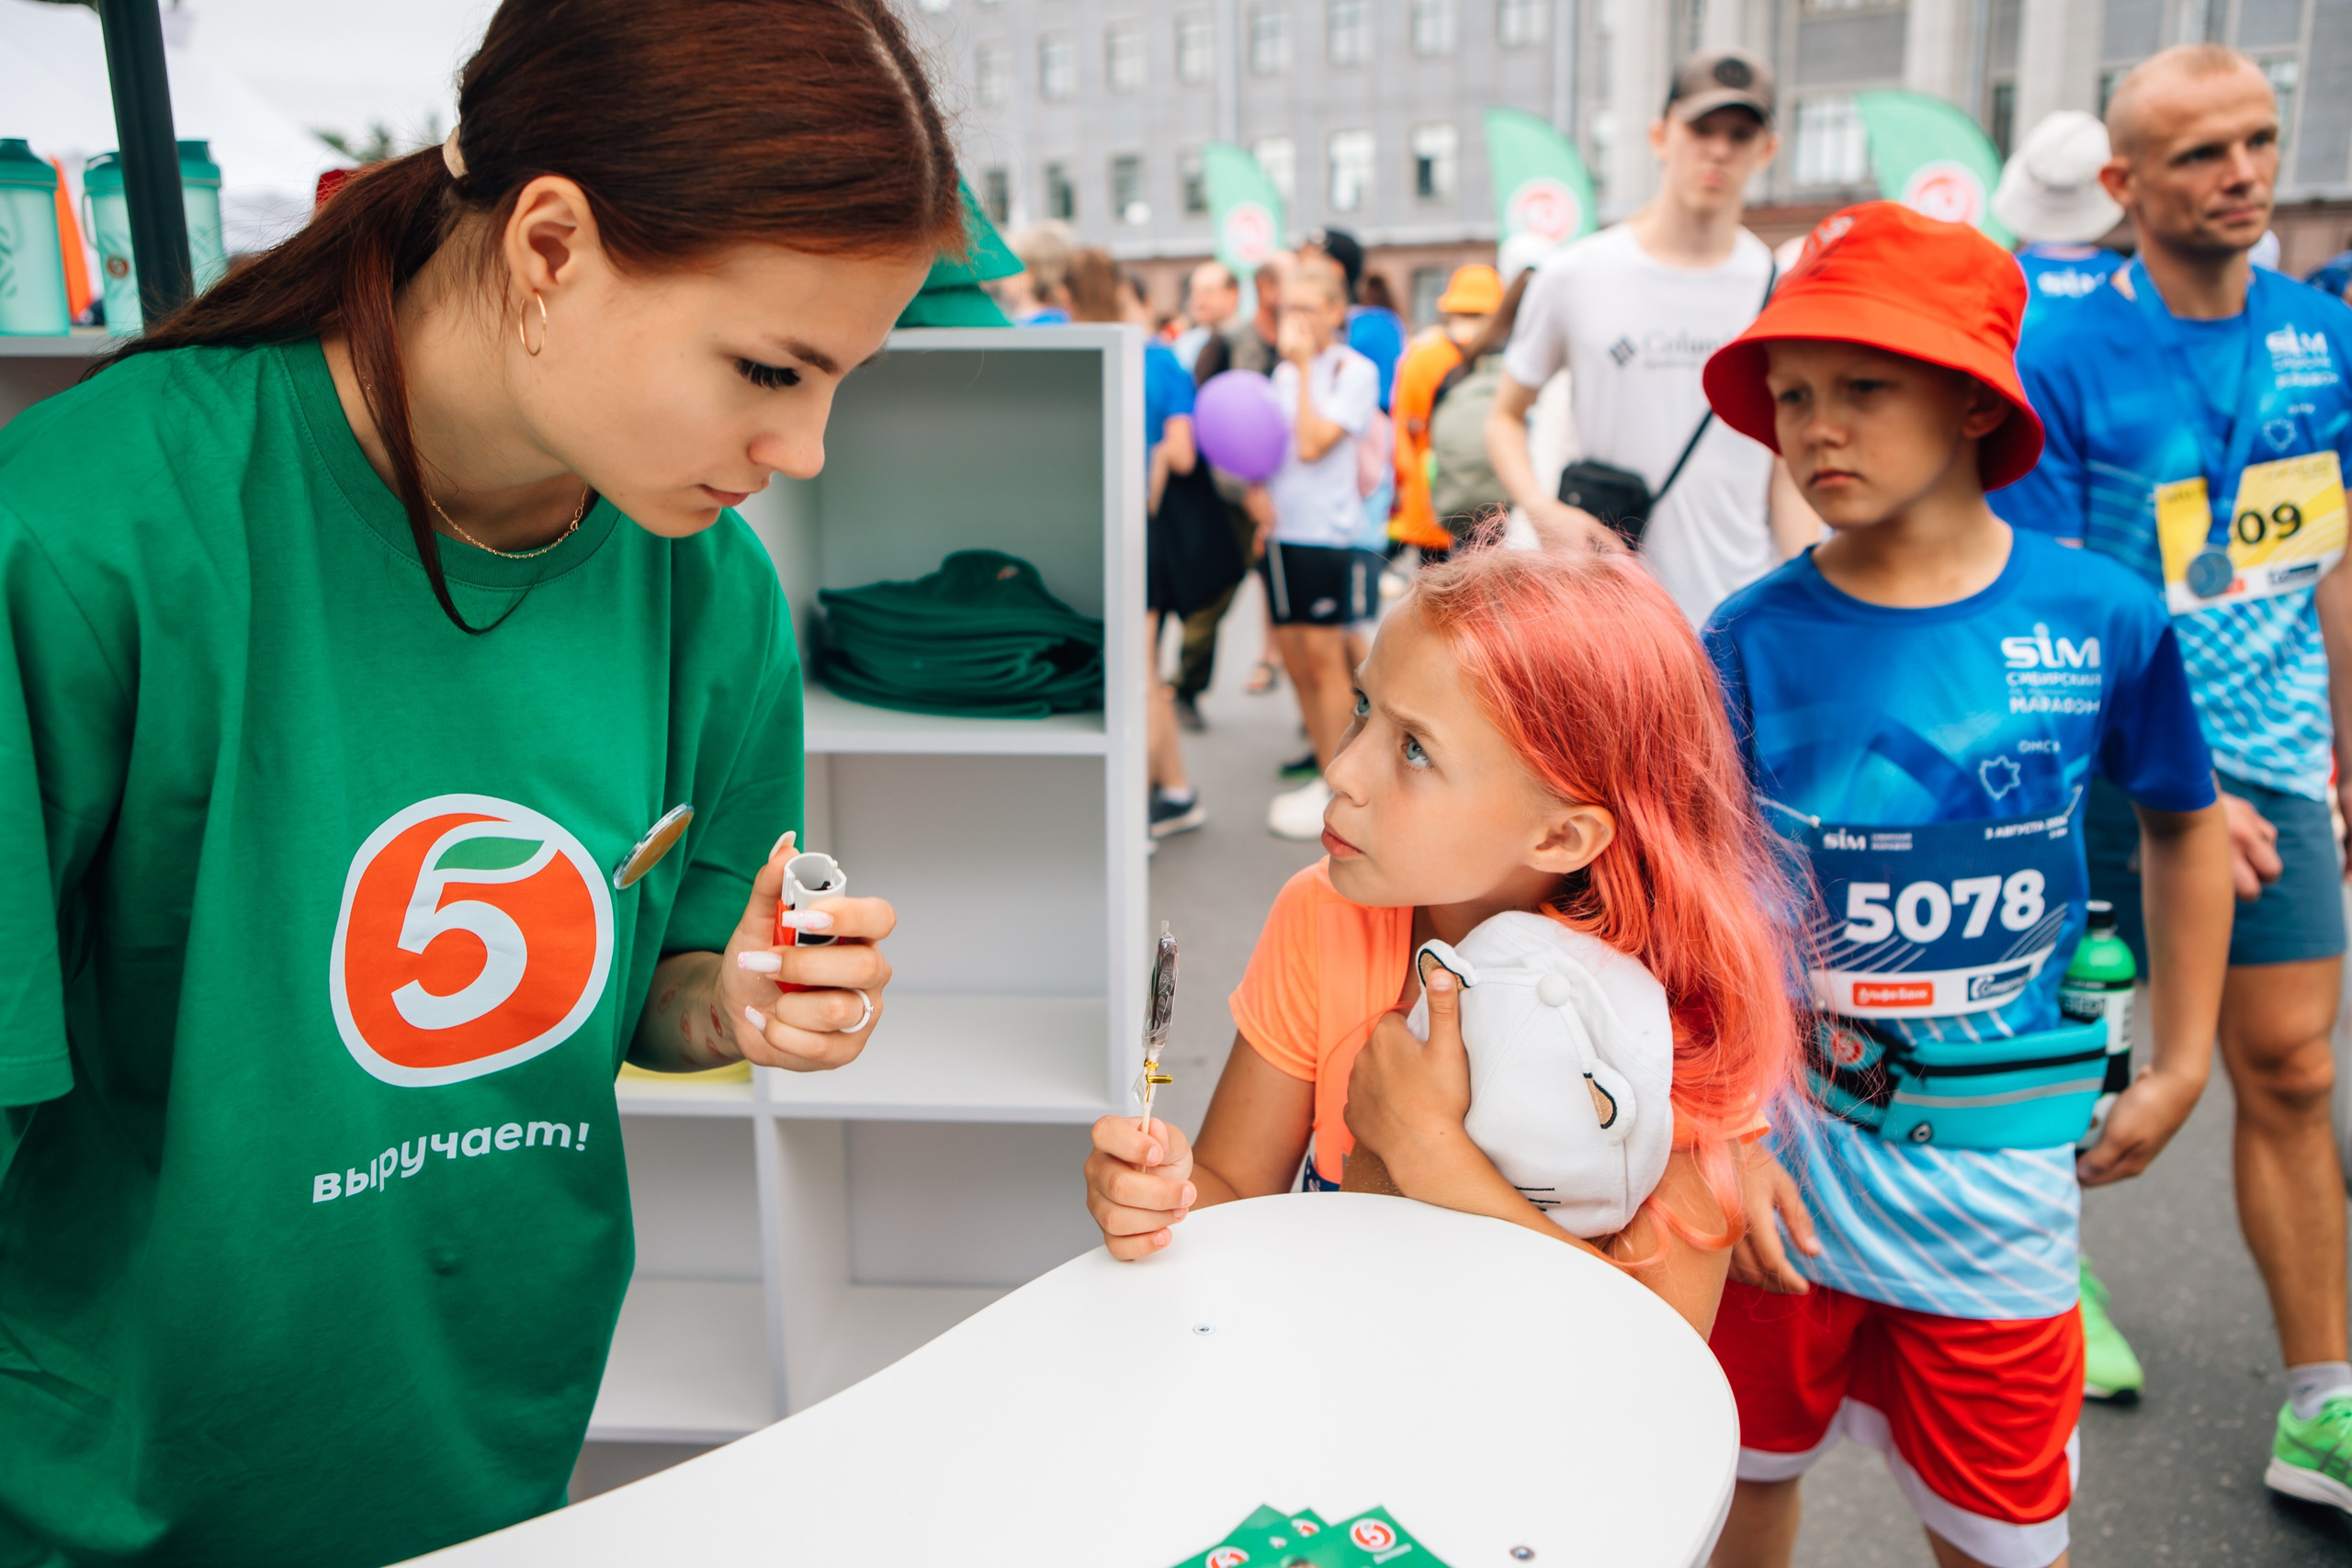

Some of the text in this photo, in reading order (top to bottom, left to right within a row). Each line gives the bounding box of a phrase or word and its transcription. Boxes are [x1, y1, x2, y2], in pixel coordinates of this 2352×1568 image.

[2235, 503, 2302, 545] 09
[1843, 869, 2045, 943] 5078
[312, 1121, 590, 1203] выручает!
